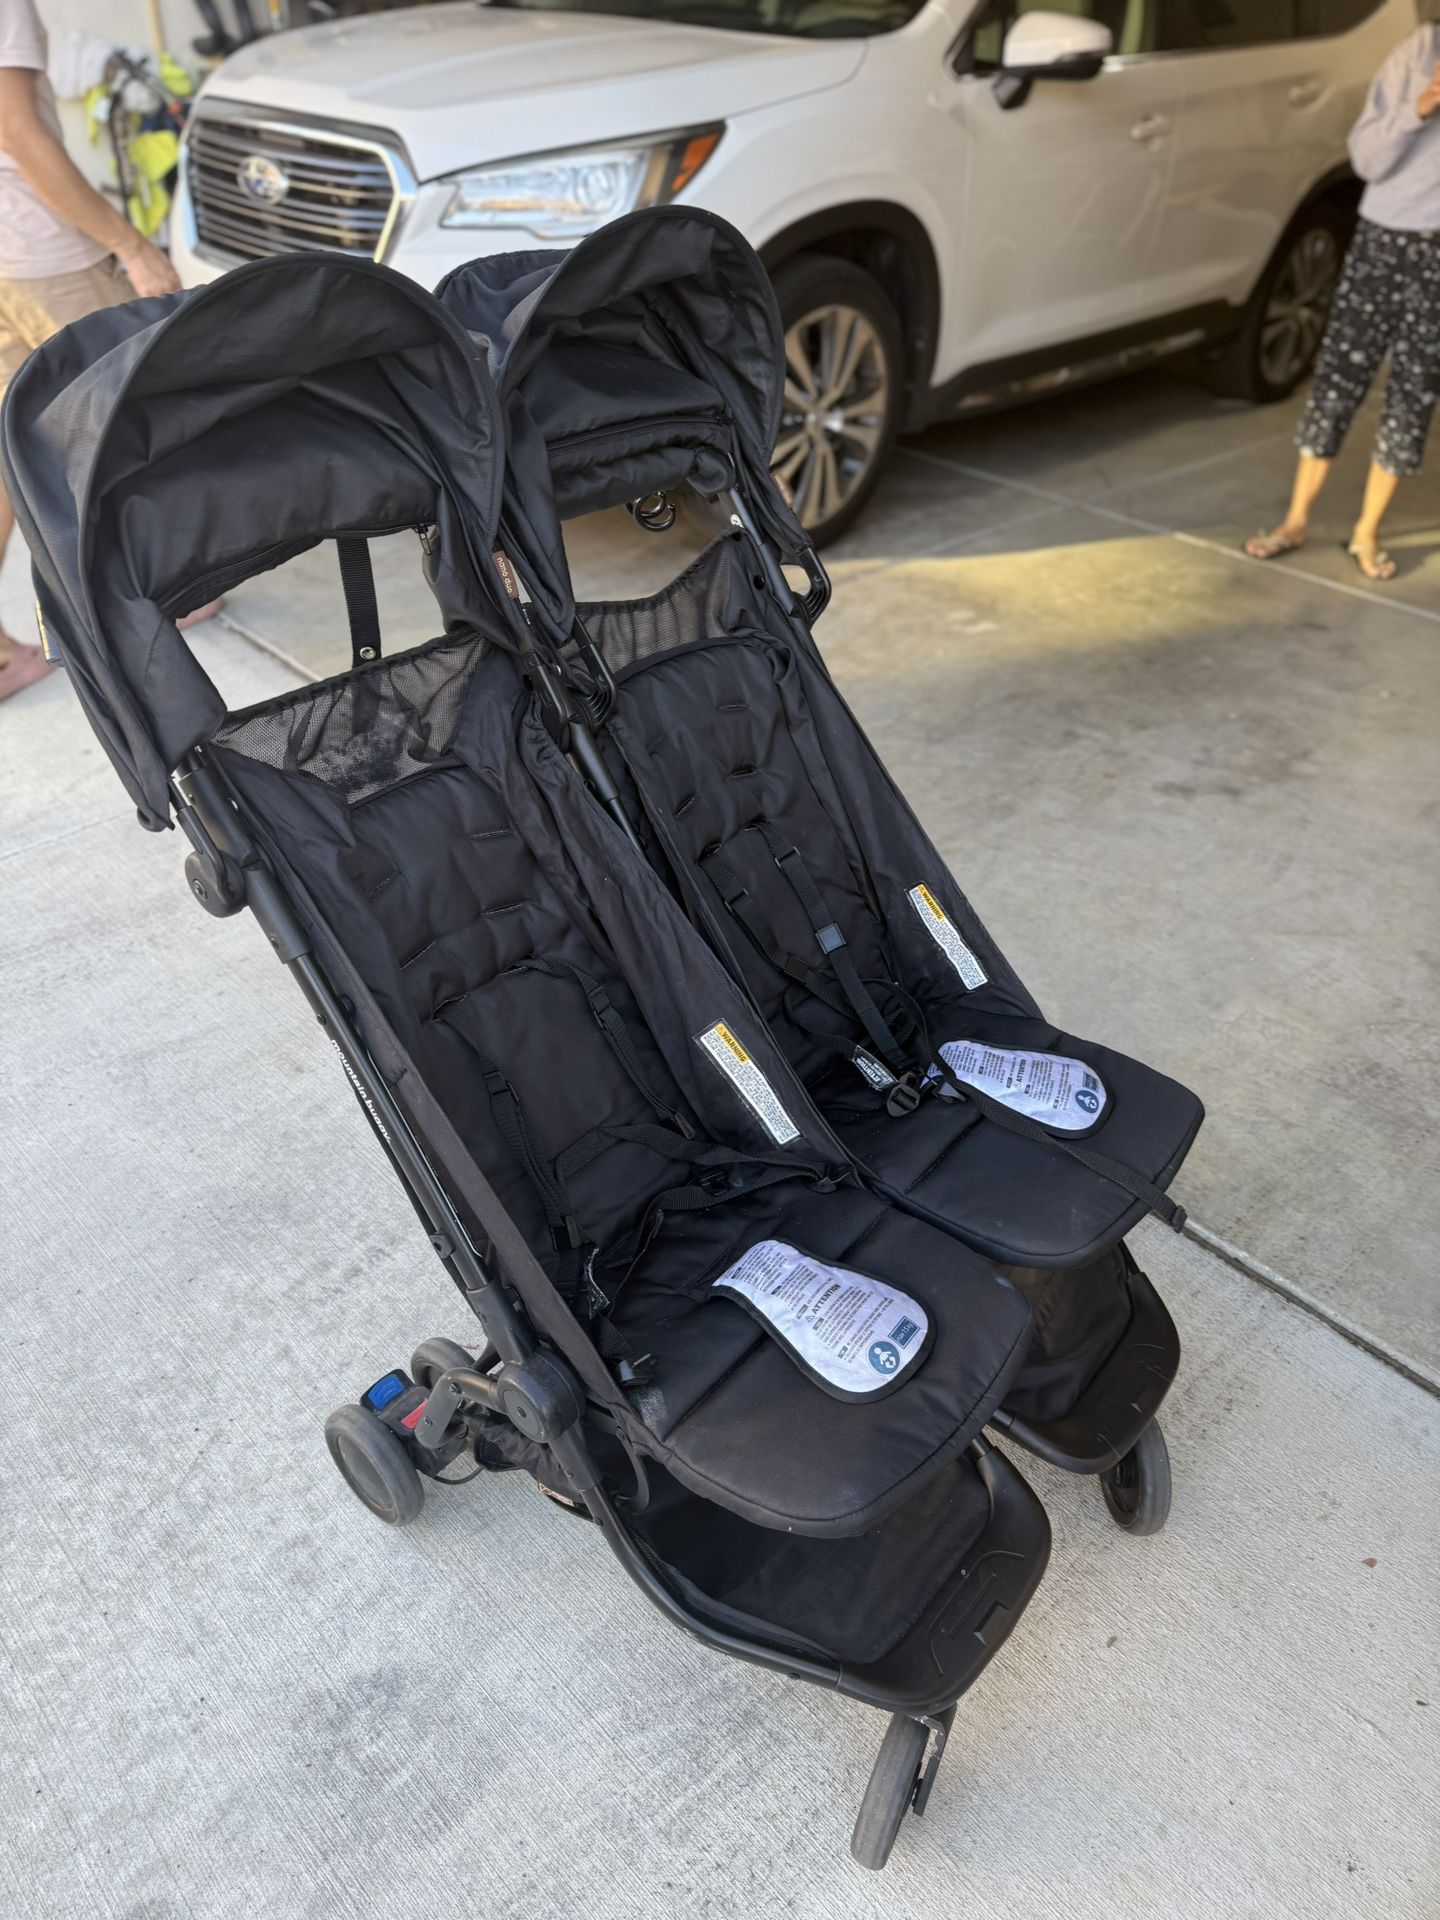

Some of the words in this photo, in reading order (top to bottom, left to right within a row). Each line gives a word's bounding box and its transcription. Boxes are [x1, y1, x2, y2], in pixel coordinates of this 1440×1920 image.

[497, 557, 508, 577] nano
[504, 578, 513, 593] duo
[922, 892, 943, 919] WARNING
[721, 1030, 747, 1062] WARNING
[331, 1039, 367, 1099] mountain
[812, 1282, 841, 1314] ATTENTION
